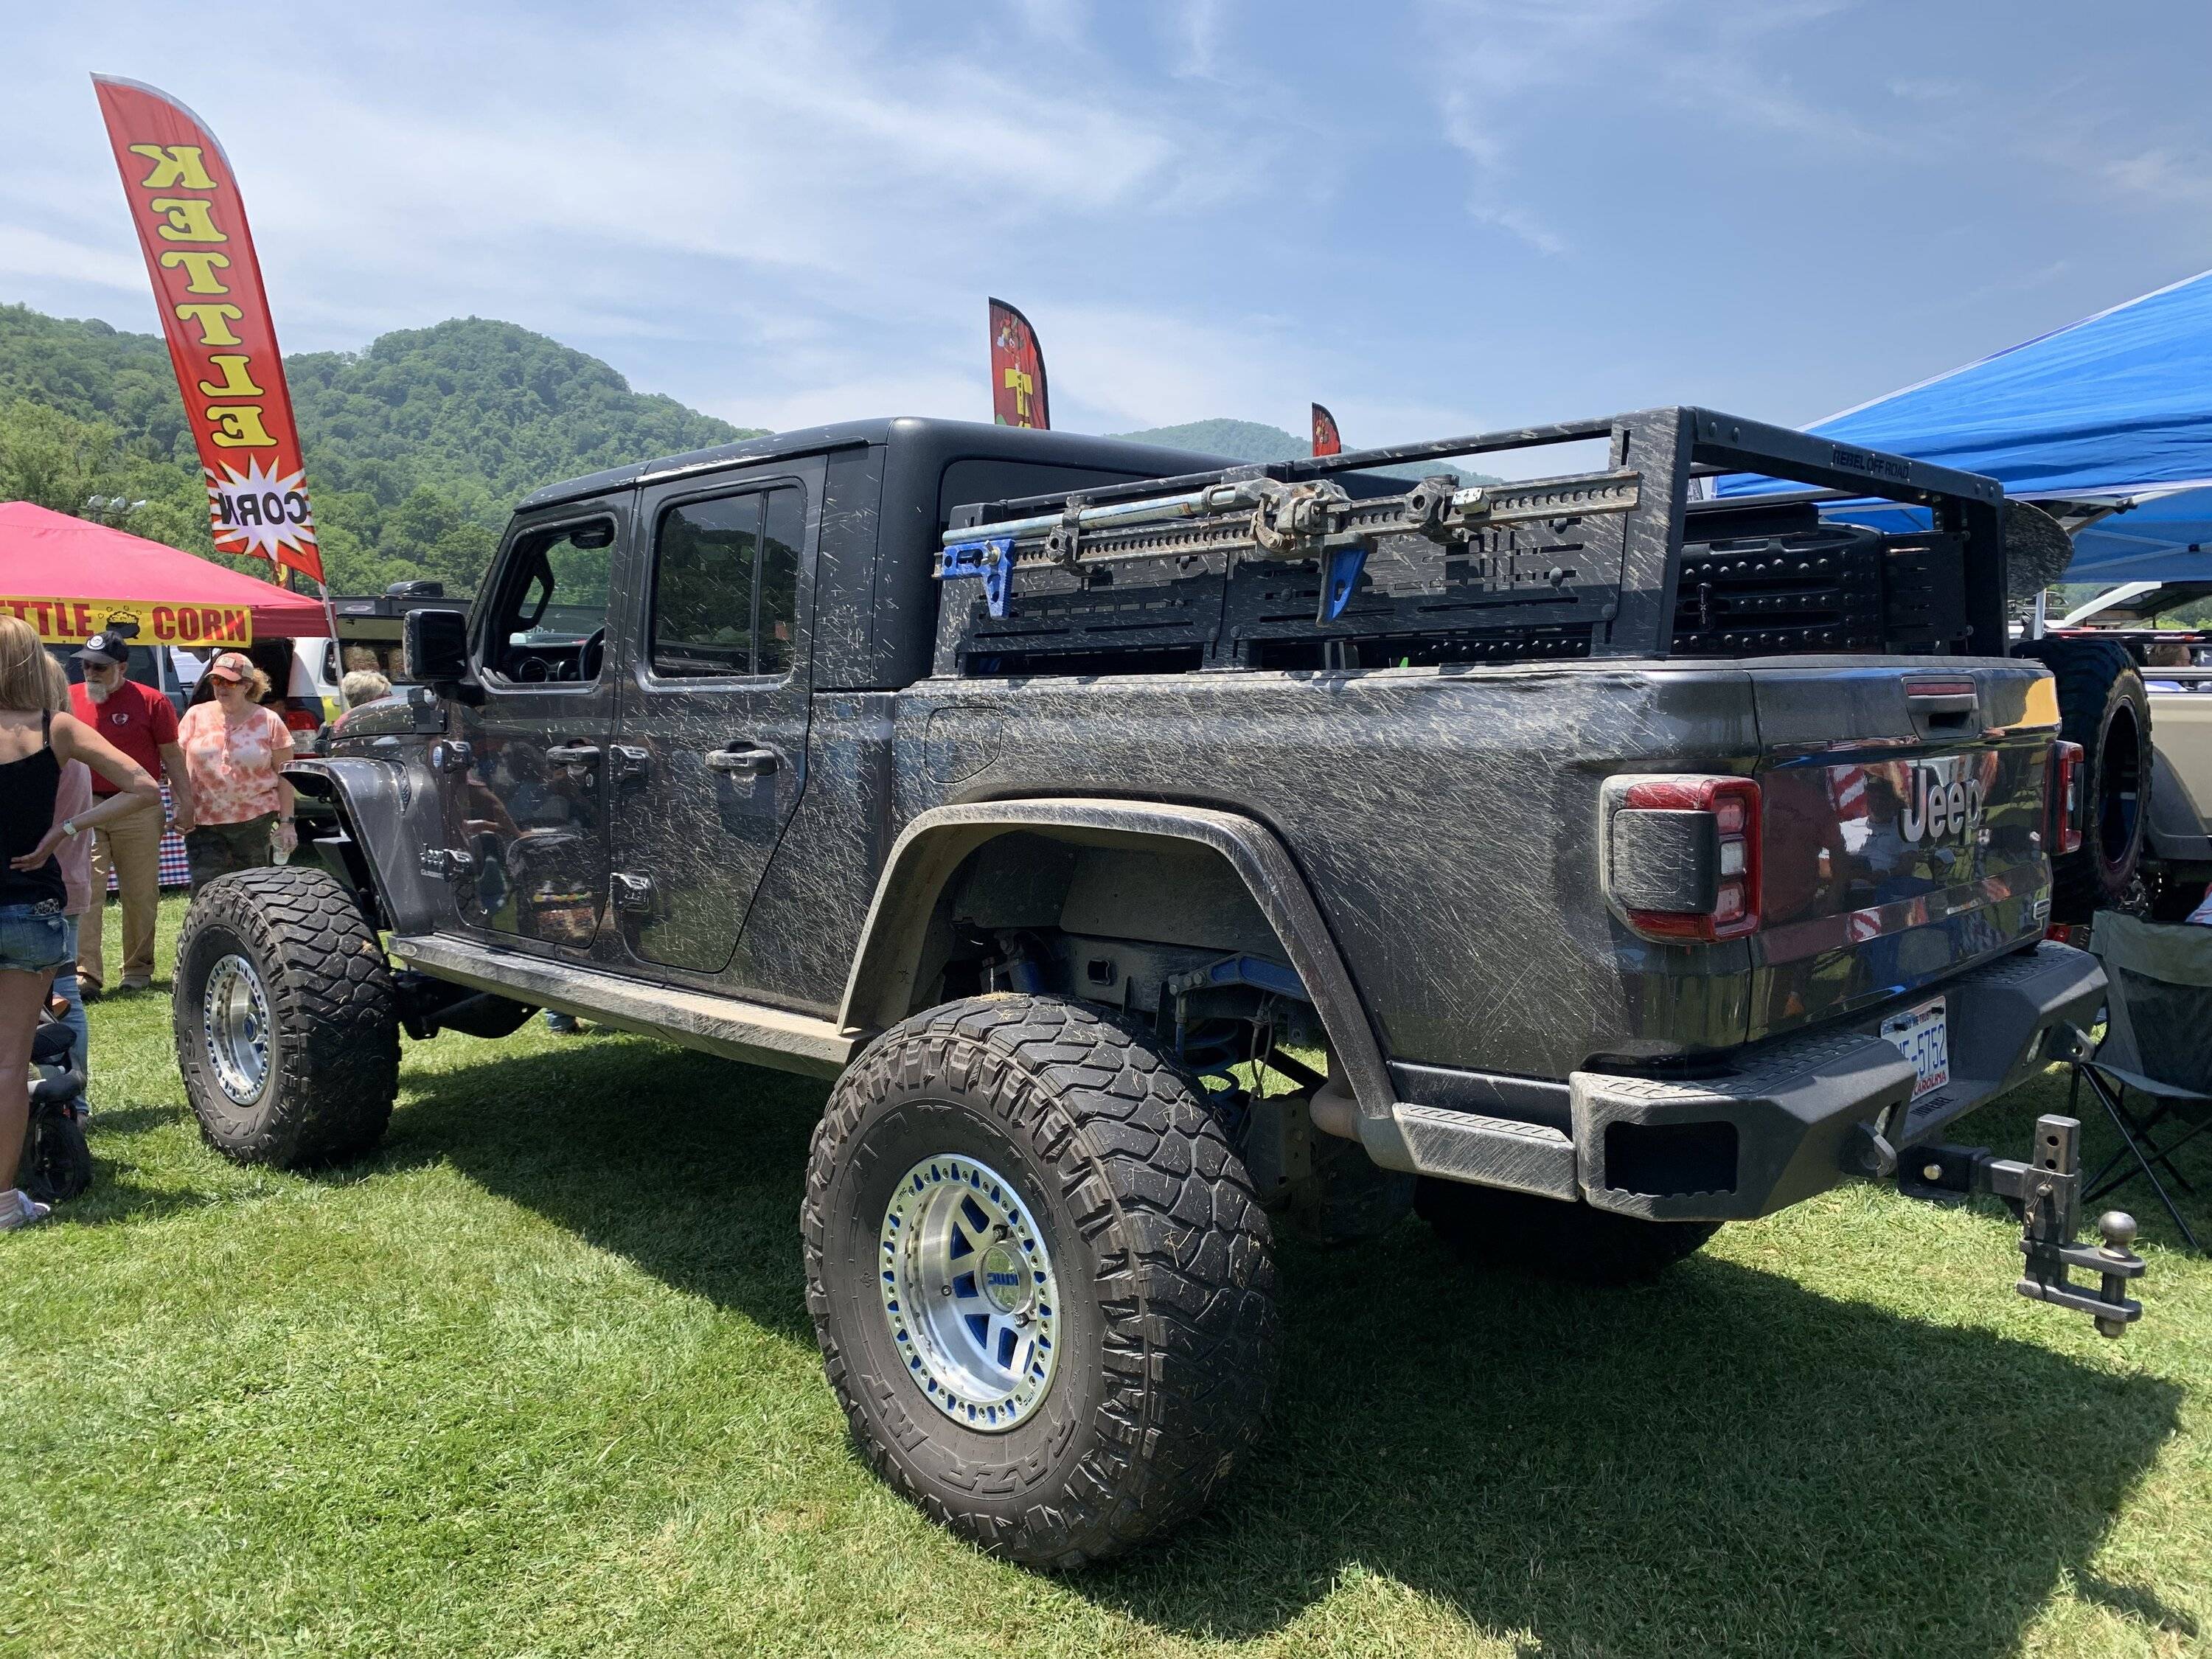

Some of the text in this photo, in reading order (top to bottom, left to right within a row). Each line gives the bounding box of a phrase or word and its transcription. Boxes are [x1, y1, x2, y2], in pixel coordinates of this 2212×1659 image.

[1833, 450, 1910, 479] REBEL OFF ROAD
[0, 600, 247, 641] TTLE CORN
[1897, 768, 1982, 845] Jeep
